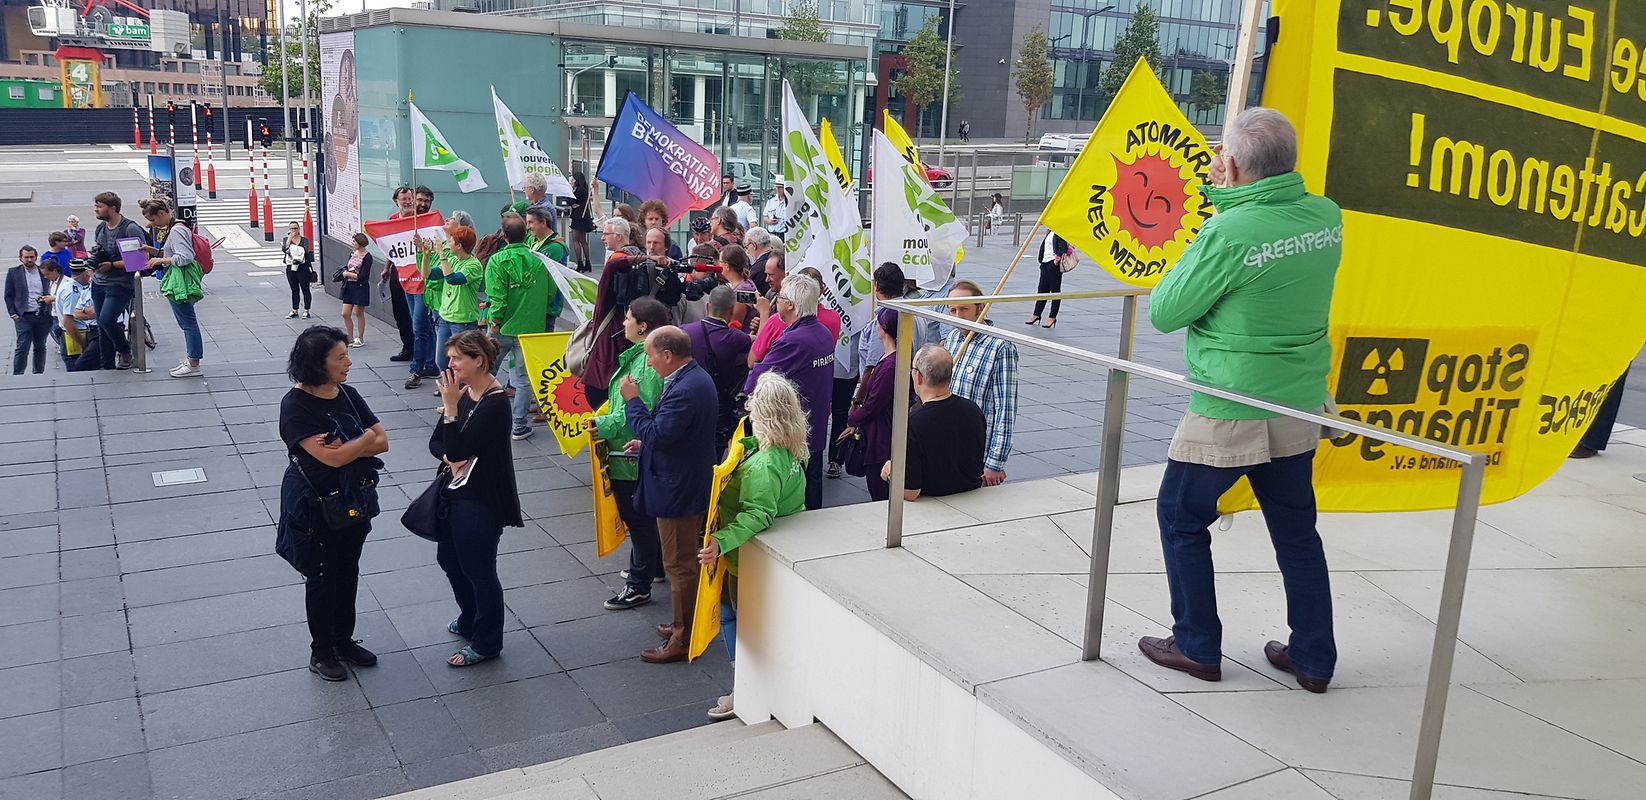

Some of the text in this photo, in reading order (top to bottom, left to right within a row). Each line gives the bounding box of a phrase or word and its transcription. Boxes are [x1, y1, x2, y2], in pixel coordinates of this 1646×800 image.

[126, 25, 147, 35] bam
[71, 63, 89, 82] 4
[637, 111, 719, 188] DEMOKRATIE IN
[1087, 184, 1167, 279] NEE MERCI
[1243, 224, 1342, 267] GREENPEAC
[388, 241, 407, 259] déi
